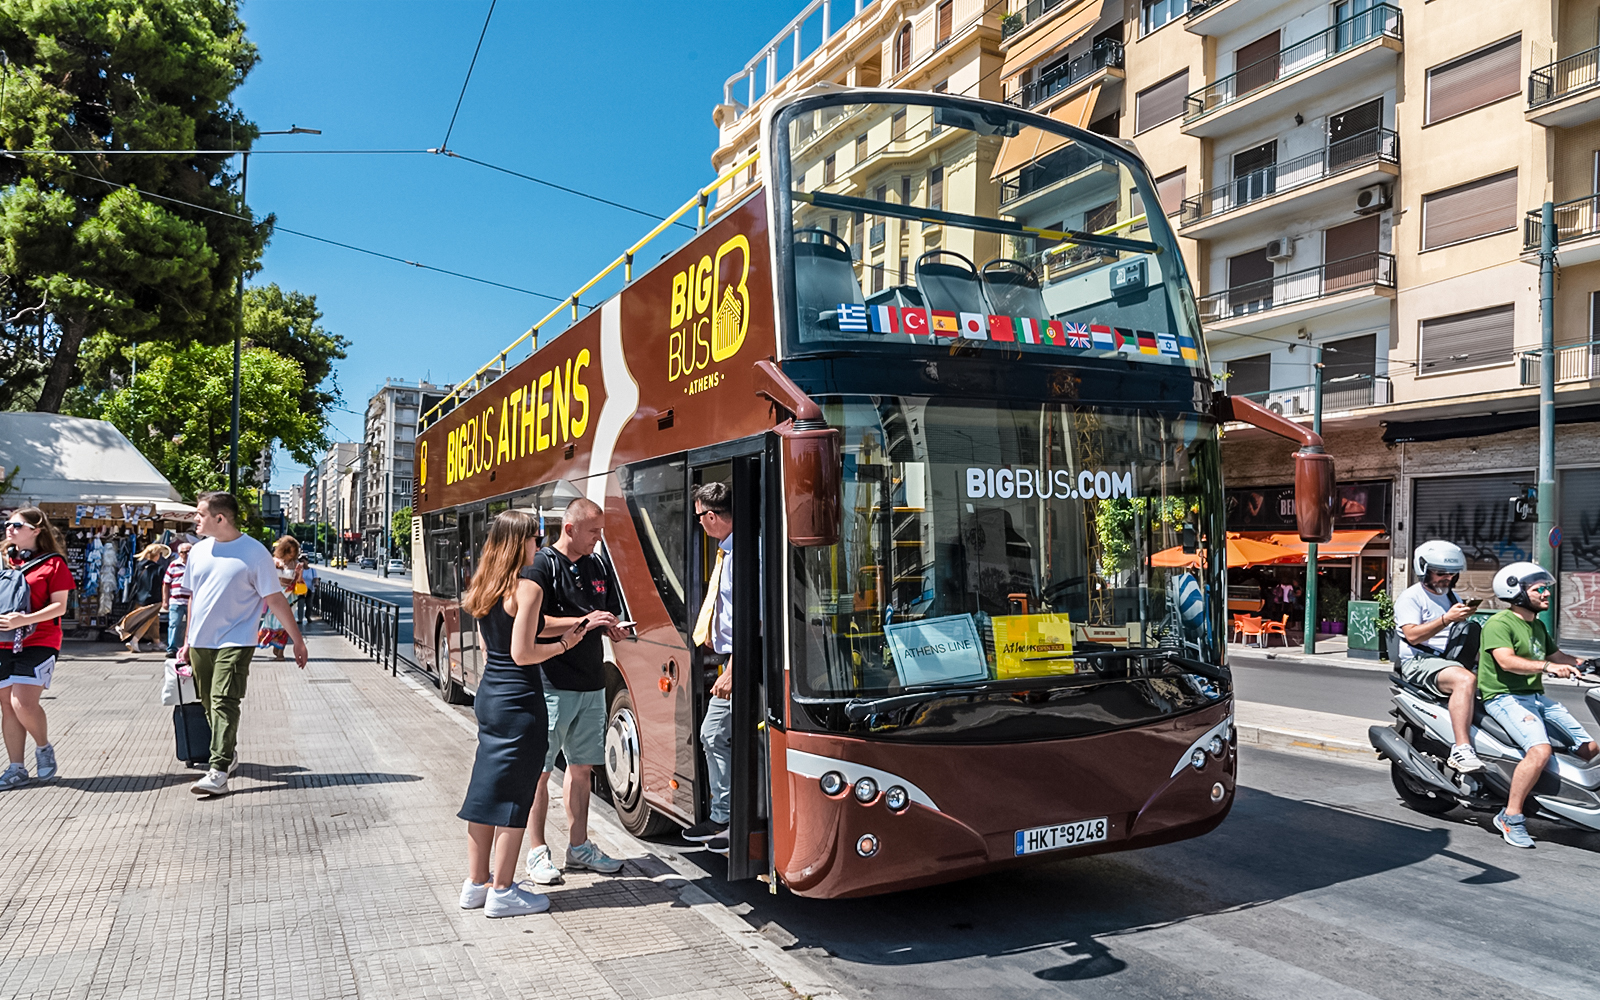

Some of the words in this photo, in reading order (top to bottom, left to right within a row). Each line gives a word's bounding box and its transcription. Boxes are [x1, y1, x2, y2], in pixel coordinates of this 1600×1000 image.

[670, 254, 713, 330] BIG
[668, 316, 710, 382] BUS
[688, 371, 719, 395] ATHENS
[446, 405, 495, 486] BIGBUS
[496, 348, 591, 466] ATHENS
[966, 467, 1132, 500] BIGBUS.COM
[1516, 500, 1533, 520] Coffee
[904, 643, 947, 659] ATHENS
[948, 639, 972, 652] LINE
[1003, 642, 1037, 653] Athens
